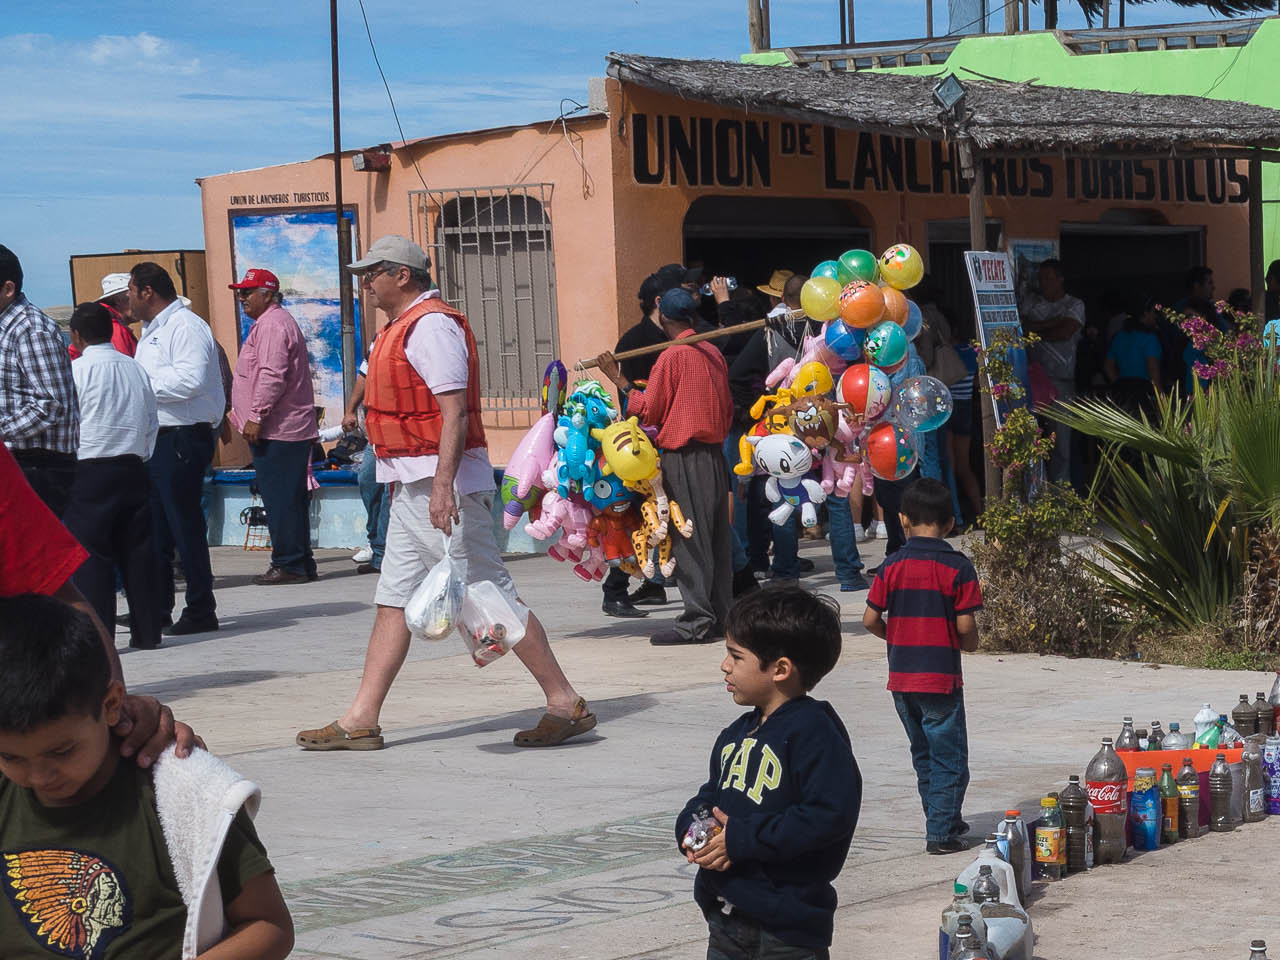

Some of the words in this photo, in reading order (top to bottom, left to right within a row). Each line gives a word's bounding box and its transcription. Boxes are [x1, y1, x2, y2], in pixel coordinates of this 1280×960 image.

[632, 113, 771, 188] UNION
[780, 122, 815, 156] DE
[293, 191, 330, 203] TURISTICOS
